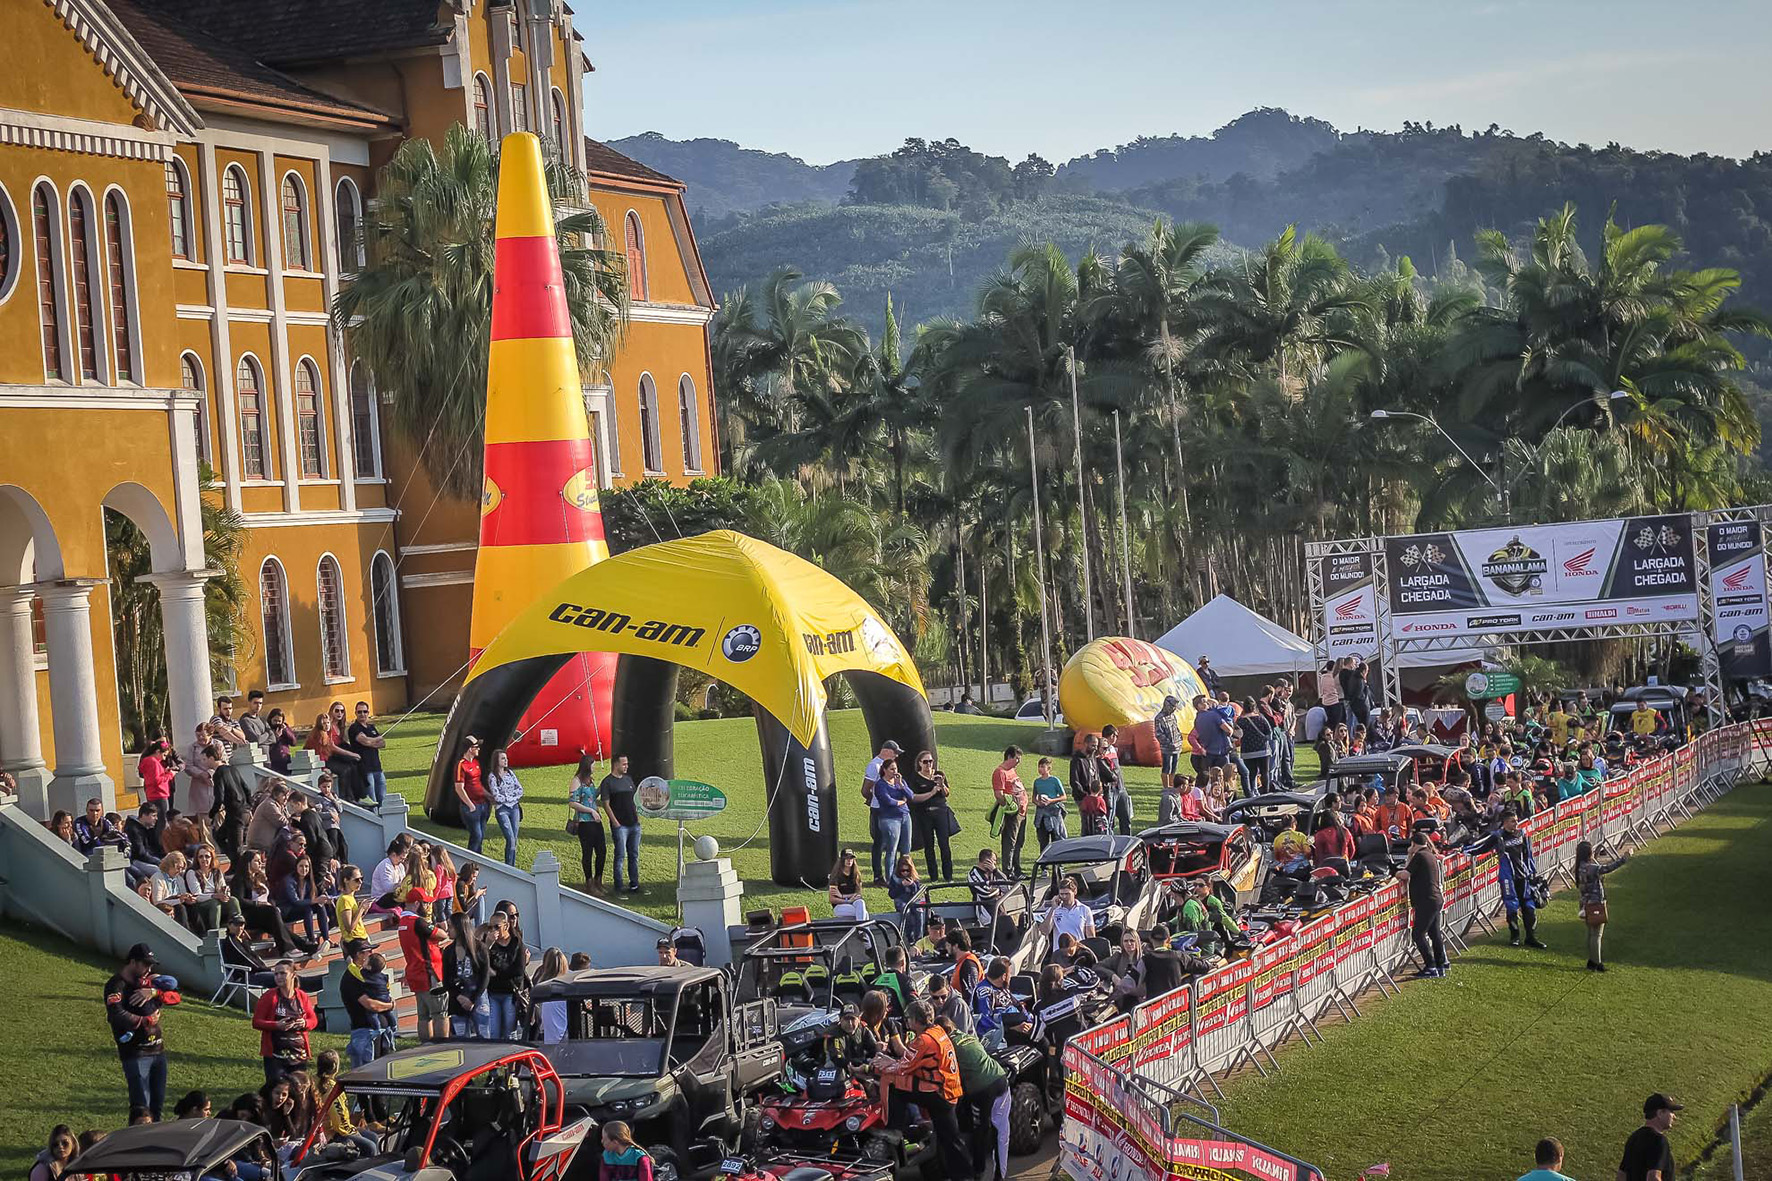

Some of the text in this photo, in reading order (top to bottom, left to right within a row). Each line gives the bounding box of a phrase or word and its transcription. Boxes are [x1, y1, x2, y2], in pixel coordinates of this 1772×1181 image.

[1726, 526, 1748, 534] MAIOR
[1717, 543, 1727, 551] DO
[1339, 556, 1360, 565] MAIOR
[1634, 557, 1685, 570] LARGADA
[1482, 562, 1547, 576] BANANALAMA
[1400, 574, 1450, 587] LARGADA
[1634, 572, 1687, 586] CHEGADA
[1400, 589, 1452, 603] CHEGADA
[1531, 612, 1576, 622] can-am
[1587, 610, 1616, 618] RINALDI
[1719, 608, 1763, 618] can-am
[548, 602, 707, 648] can-am
[1499, 616, 1519, 624] TORK
[1414, 623, 1458, 632] HONDA
[1331, 636, 1374, 647] can-am
[735, 643, 759, 653] BRP
[807, 757, 820, 833] can-am
